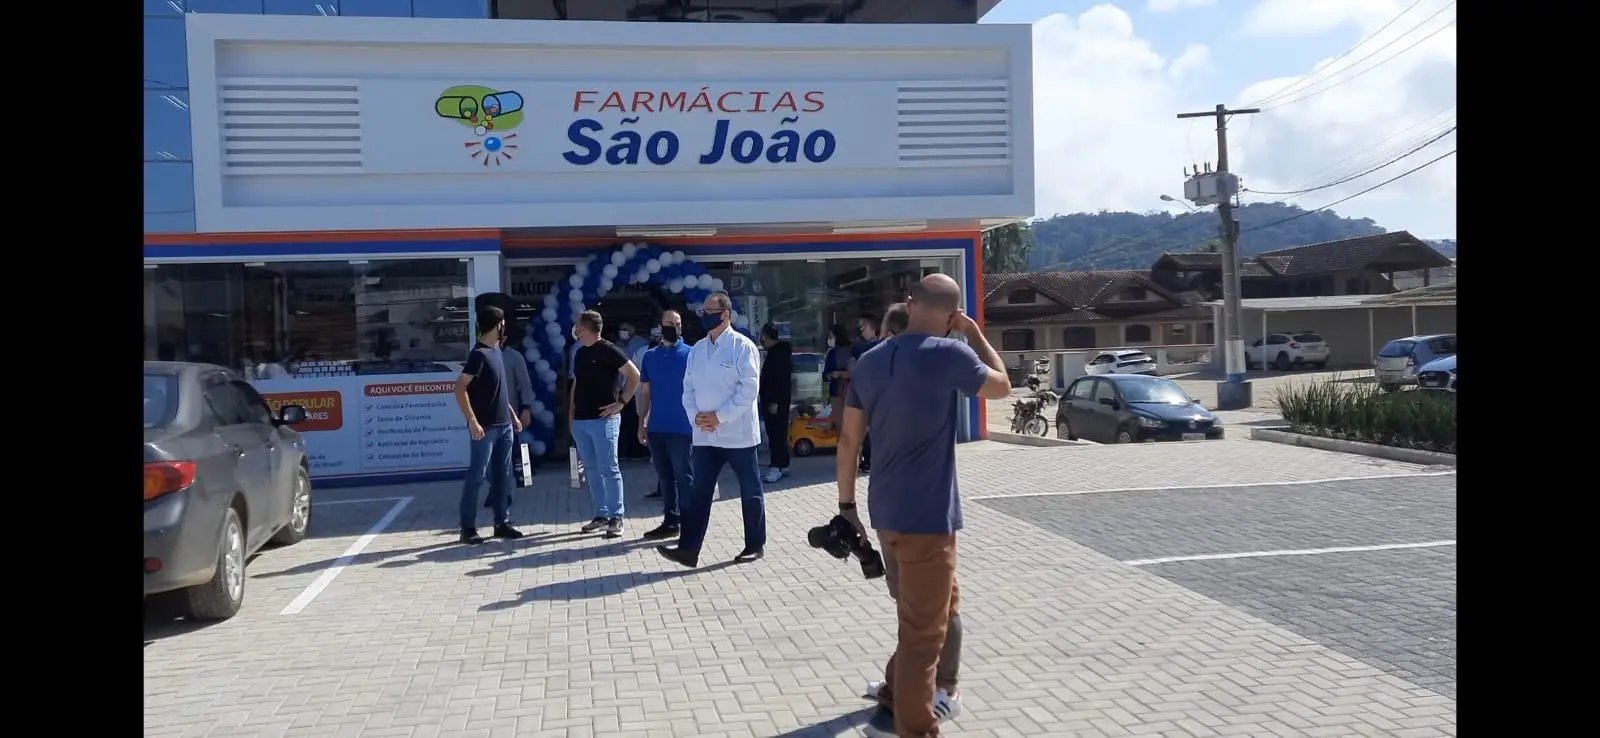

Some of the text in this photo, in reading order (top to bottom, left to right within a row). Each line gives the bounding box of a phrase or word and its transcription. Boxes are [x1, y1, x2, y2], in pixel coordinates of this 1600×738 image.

[573, 87, 825, 112] FARMÁCIAS
[562, 115, 836, 165] São João
[370, 386, 391, 394] AQUI
[391, 385, 413, 393] VOCÊ
